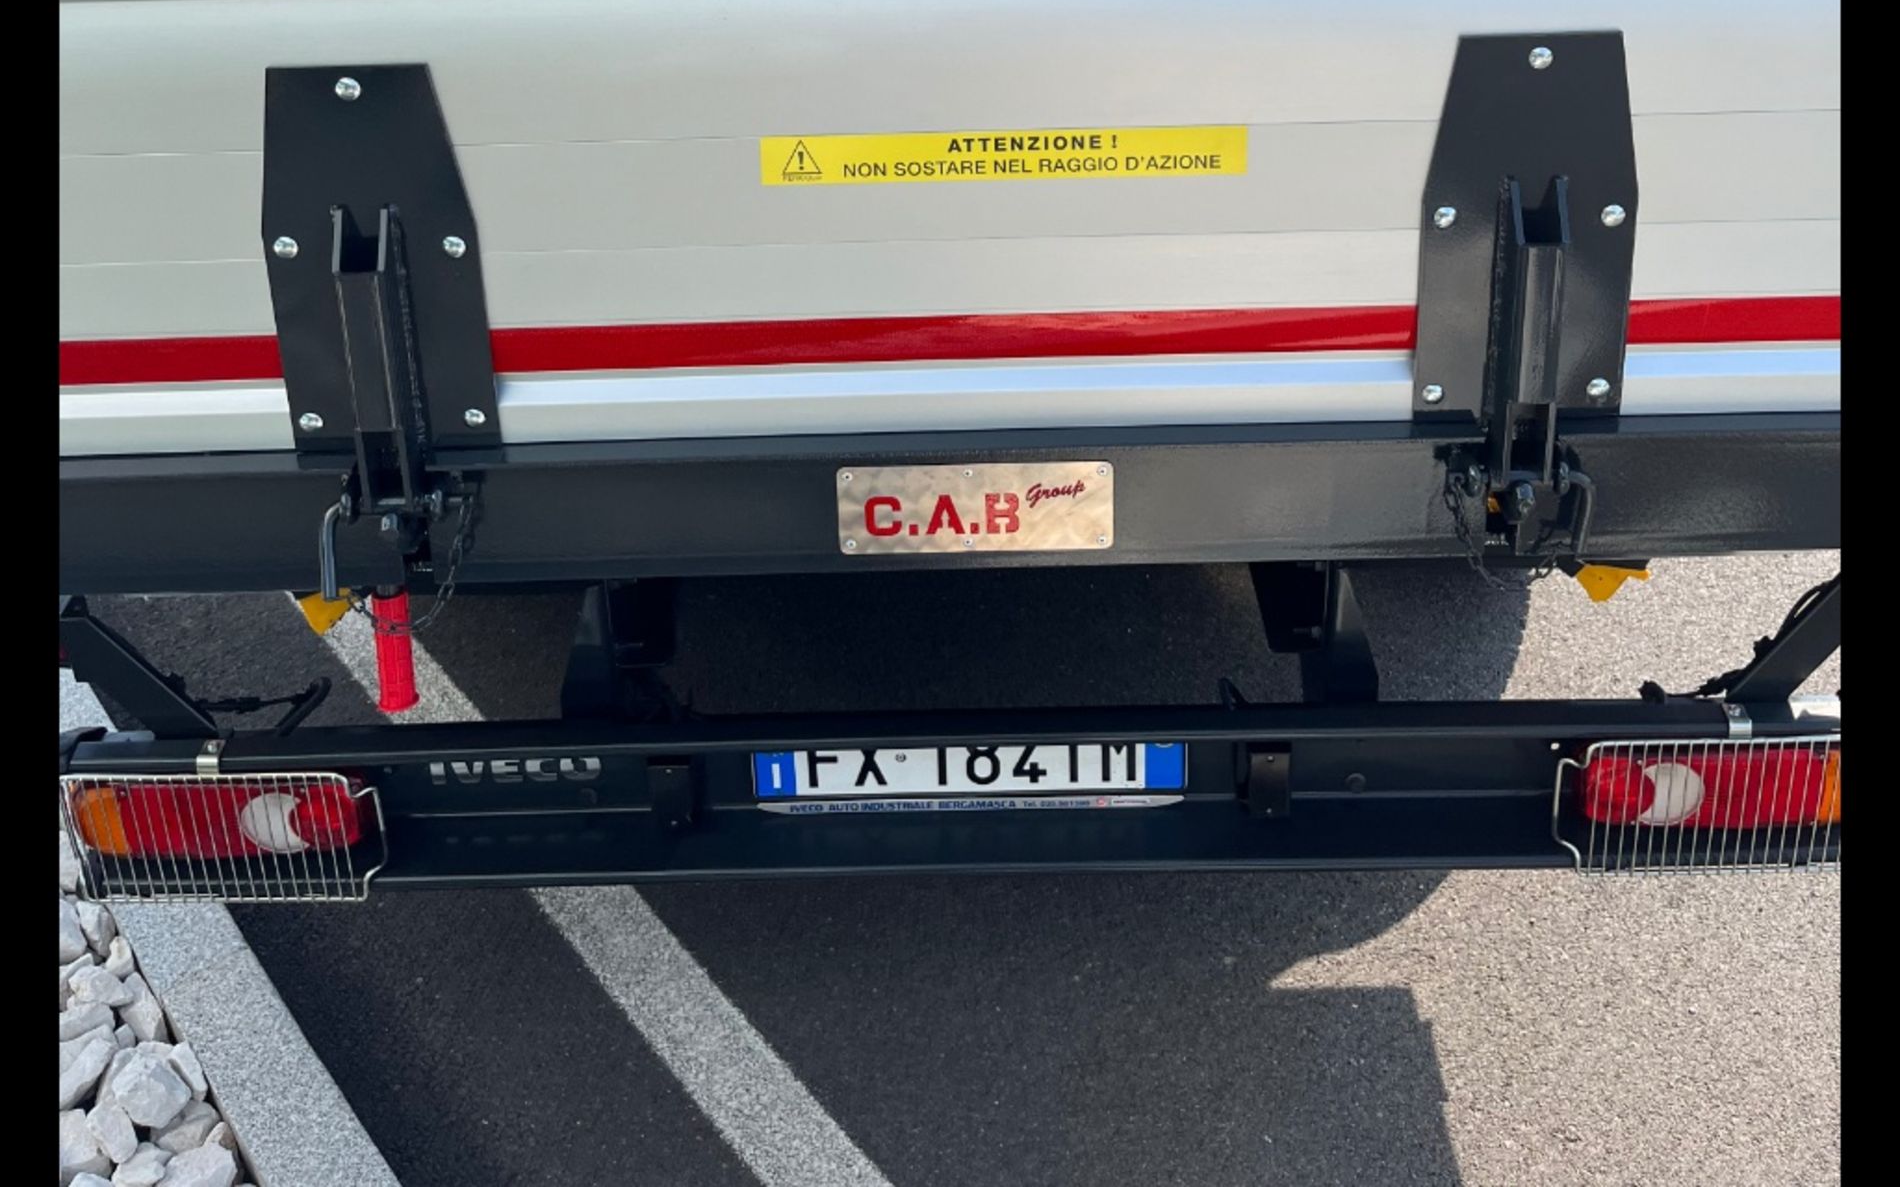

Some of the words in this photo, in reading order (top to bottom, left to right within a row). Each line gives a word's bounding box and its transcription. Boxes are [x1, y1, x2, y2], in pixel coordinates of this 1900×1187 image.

[948, 136, 1102, 153] ATTENZIONE
[843, 163, 887, 178] NON
[894, 160, 986, 177] SOSTARE
[994, 159, 1032, 174] NEL
[1039, 157, 1118, 173] RAGGIO
[1125, 155, 1222, 172] D'AZIONE
[1025, 479, 1086, 509] Group
[864, 493, 1020, 537] C.A.B
[429, 757, 601, 785] IVECO
